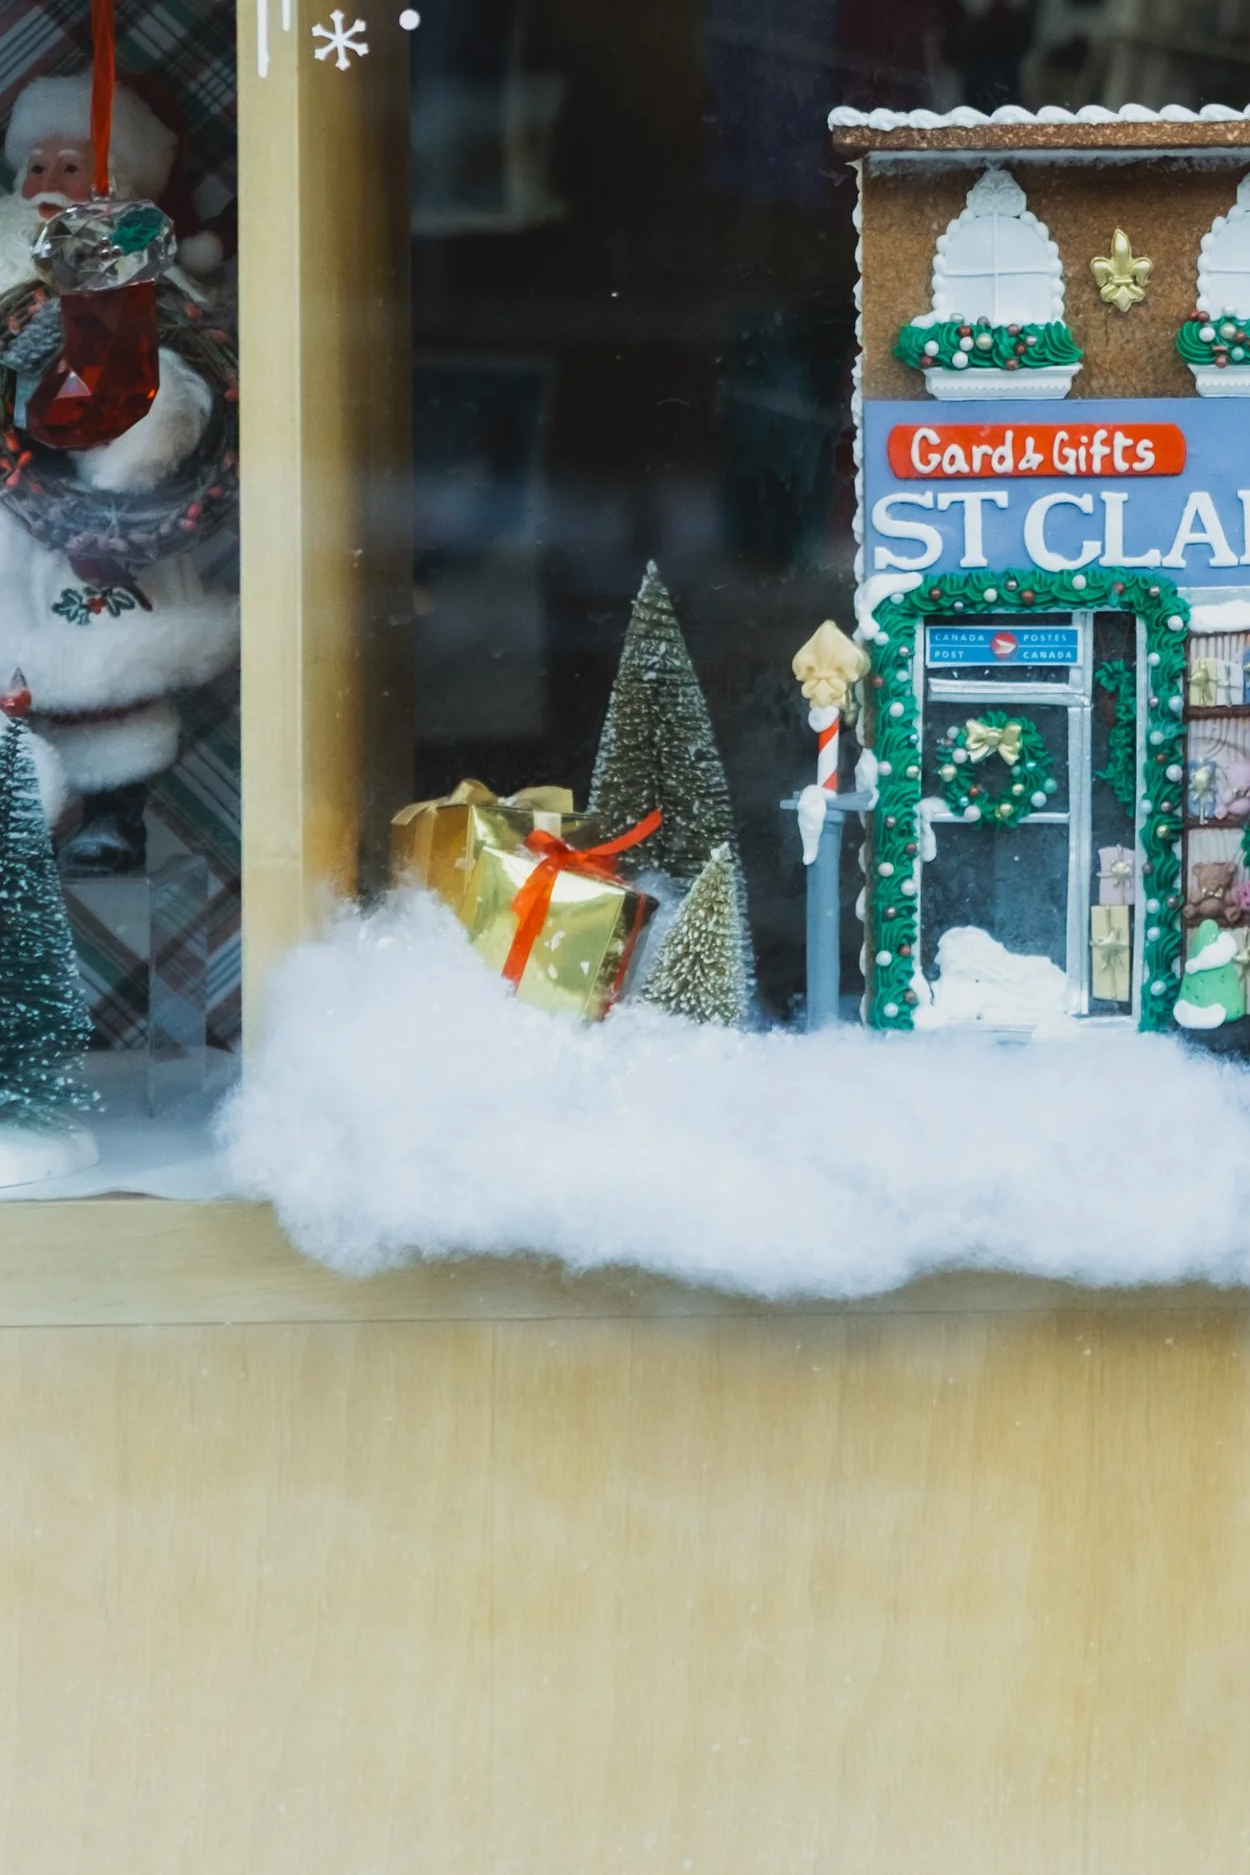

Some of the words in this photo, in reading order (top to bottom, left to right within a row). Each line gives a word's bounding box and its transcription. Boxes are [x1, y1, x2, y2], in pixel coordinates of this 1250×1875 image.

[1052, 429, 1156, 474] Gifts
[871, 490, 1008, 570] ST
[934, 633, 985, 642] CANADA
[1023, 633, 1068, 642] POSTES
[934, 650, 965, 659] POST
[1023, 650, 1073, 660] CANADA
